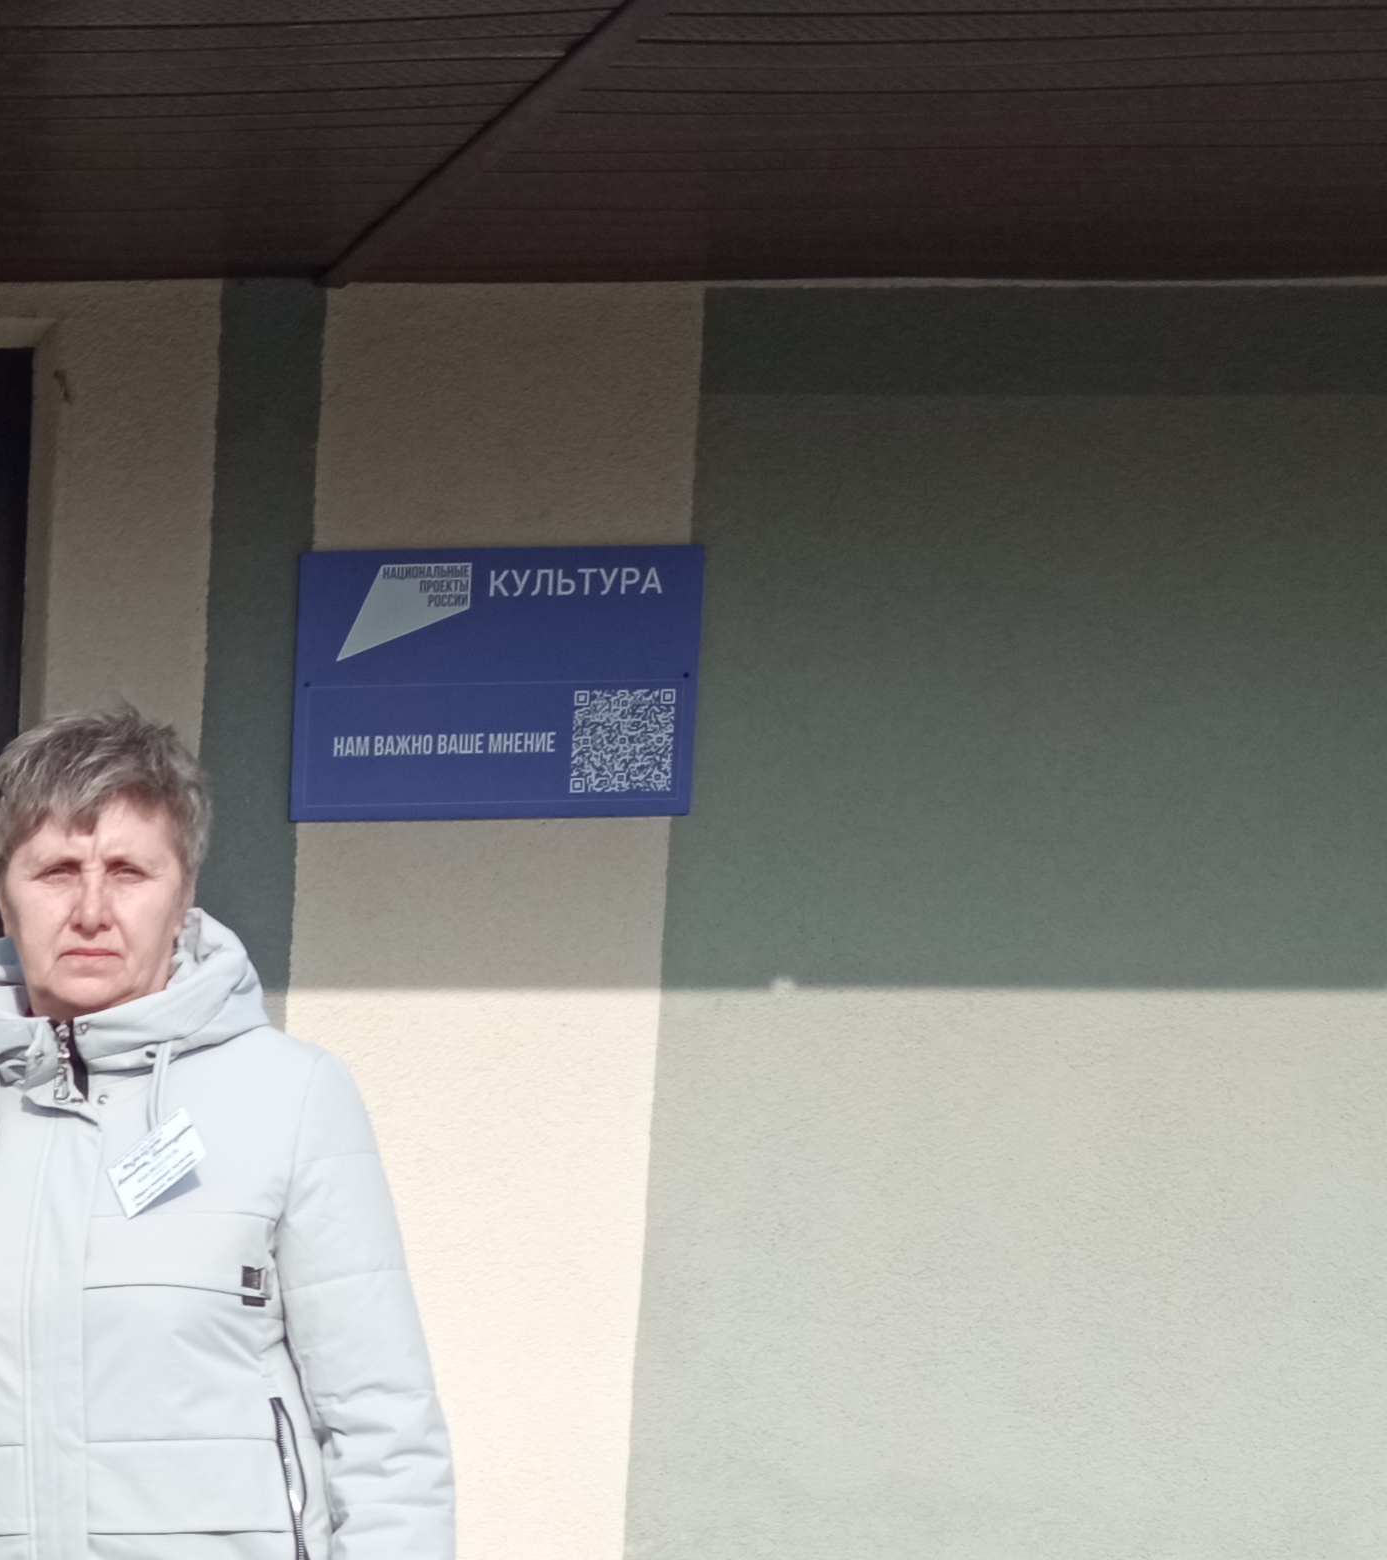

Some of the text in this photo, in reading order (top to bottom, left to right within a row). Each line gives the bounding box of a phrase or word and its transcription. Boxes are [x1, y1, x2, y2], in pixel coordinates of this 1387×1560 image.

[382, 563, 470, 580] НАЦИОНАЛЬНЫЕ
[419, 578, 469, 594] ПРОЕКТЫ
[489, 566, 663, 598] КУЛЬТУРА
[427, 592, 469, 608] РОССИИ
[333, 731, 557, 758] НАМ ВАЖНО ВАШЕ МНЕНИЕ
